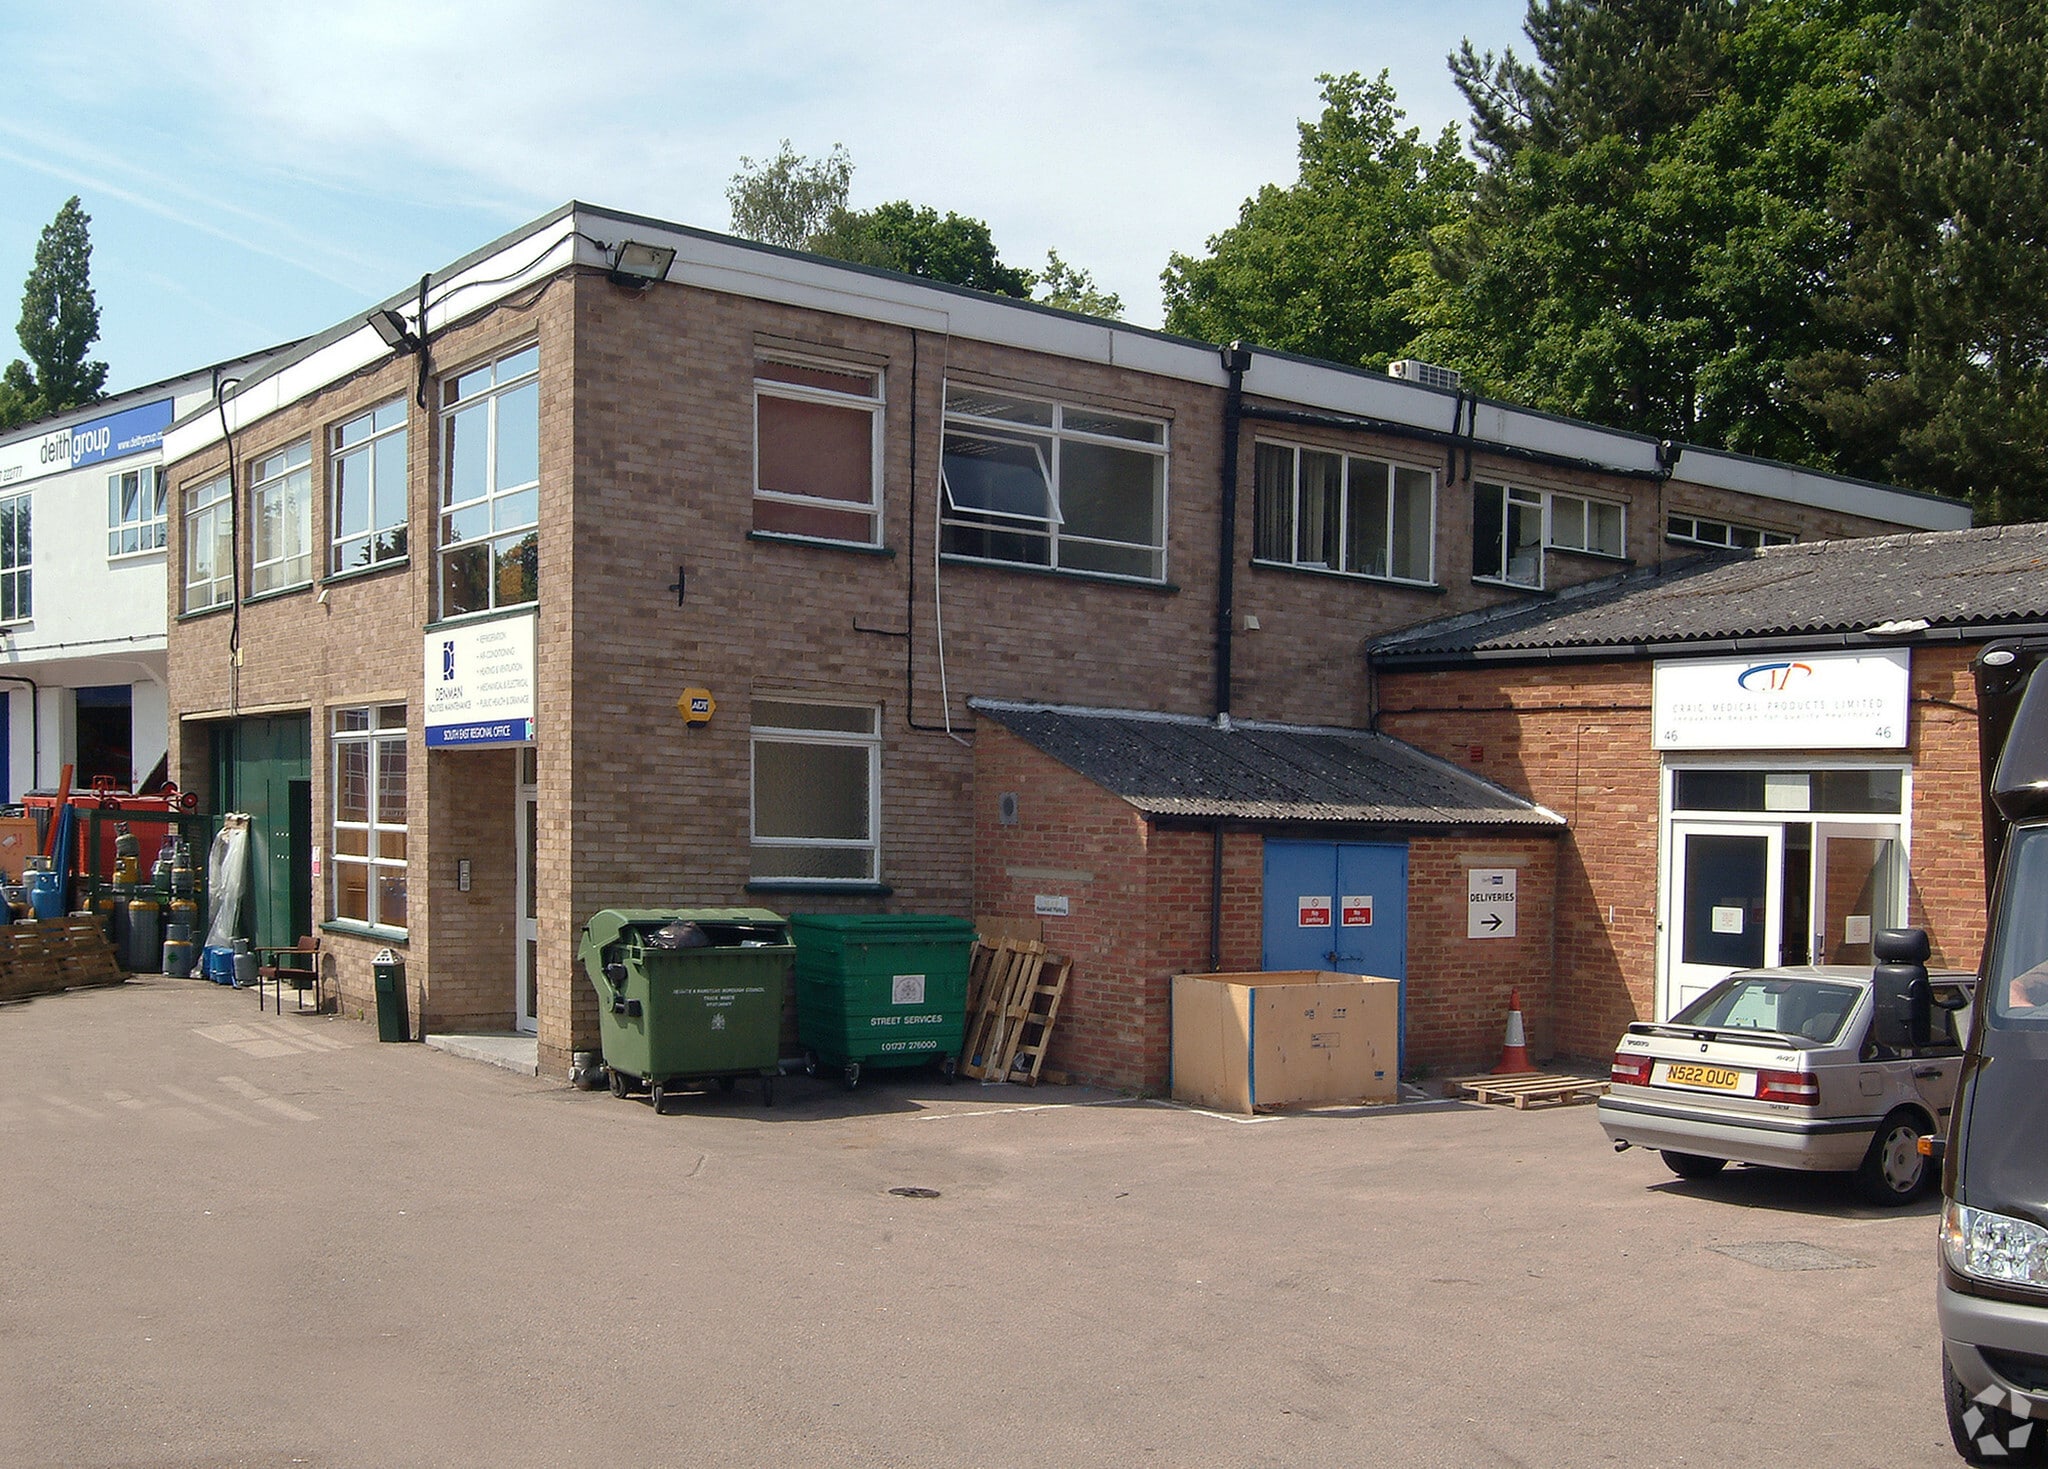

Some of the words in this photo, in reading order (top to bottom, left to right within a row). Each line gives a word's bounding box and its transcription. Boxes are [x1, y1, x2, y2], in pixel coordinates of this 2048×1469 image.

[435, 685, 463, 701] DENMAN
[692, 700, 709, 711] ADT
[1672, 703, 1704, 713] CRAIG
[1712, 702, 1758, 713] MEDICAL
[1767, 700, 1825, 711] PRODUCTS
[1834, 698, 1883, 710] LIMITED
[444, 729, 459, 741] SOUTH
[459, 728, 470, 740] EAST
[470, 726, 493, 739] REGIONAL
[493, 725, 511, 737] OFFICE
[1664, 729, 1679, 742] 46
[1875, 726, 1892, 739] 46
[1470, 893, 1515, 902] DELIVERIES
[870, 1016, 902, 1027] STREET
[903, 1014, 943, 1025] SERVICES
[1667, 1066, 1702, 1083] N522
[1705, 1070, 1737, 1086] OUC
